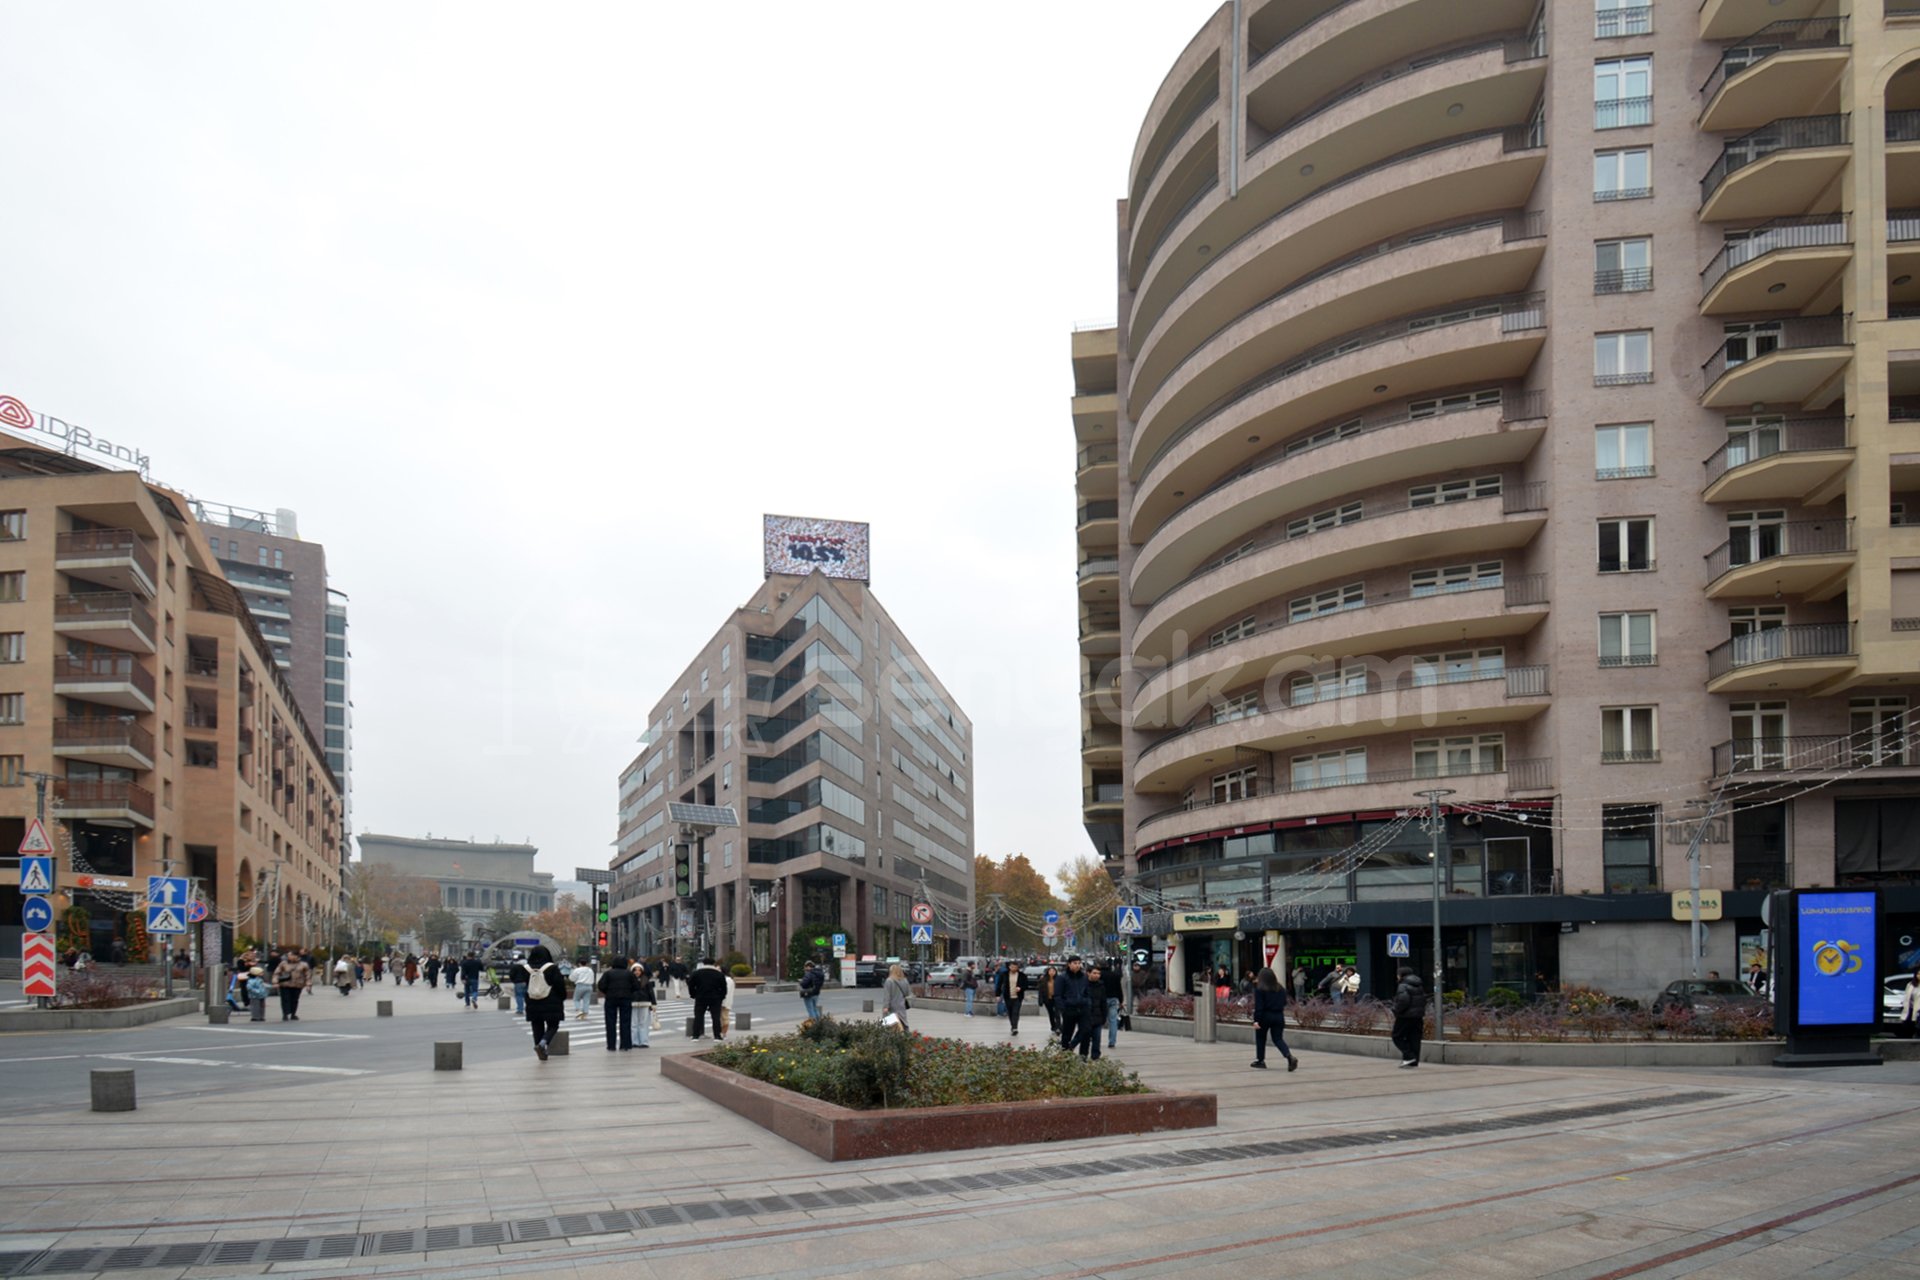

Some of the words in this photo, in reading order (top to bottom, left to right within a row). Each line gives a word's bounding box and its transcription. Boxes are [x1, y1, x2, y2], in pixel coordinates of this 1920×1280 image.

[41, 413, 149, 466] IDBank
[93, 878, 129, 888] IDBank
[1677, 899, 1719, 909] PAMA
[834, 935, 842, 945] P
